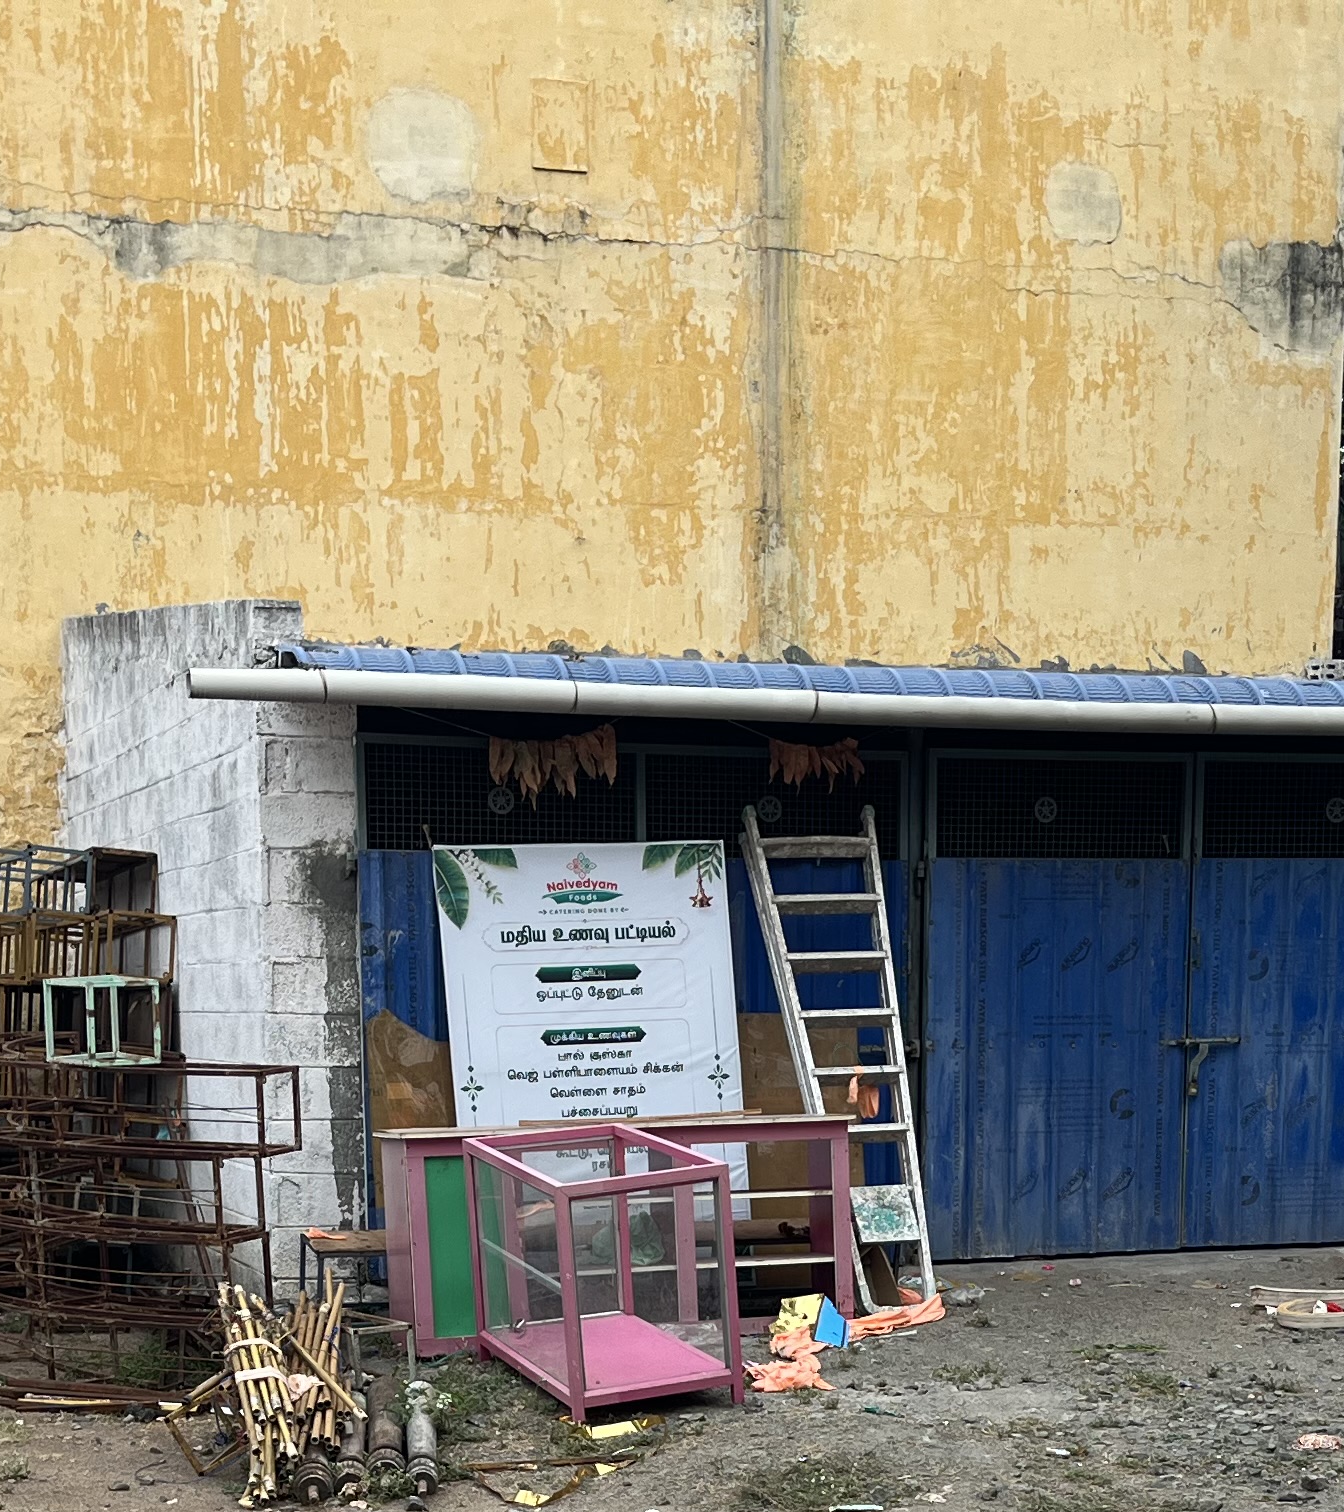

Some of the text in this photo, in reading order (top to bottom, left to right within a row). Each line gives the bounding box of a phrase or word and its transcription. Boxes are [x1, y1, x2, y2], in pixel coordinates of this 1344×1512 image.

[546, 878, 618, 892] Naivedyam
[979, 880, 988, 905] TATA
[568, 893, 597, 901] Foods
[500, 920, 676, 947] மதிய உணவு பட்டியல்
[979, 907, 988, 958] BLUESCOPE
[978, 960, 987, 985] STEEL
[536, 984, 643, 1002] ஒப்புட்டு தேனுடன்
[977, 998, 986, 1024] TATA
[550, 1029, 637, 1045] முக்கிய உணவுகள்
[558, 1048, 585, 1062] பால்
[507, 1068, 538, 1083] வெஜ்
[642, 1060, 684, 1074] சிக்கன்
[550, 1082, 646, 1099] வெள்ளை சாதம்
